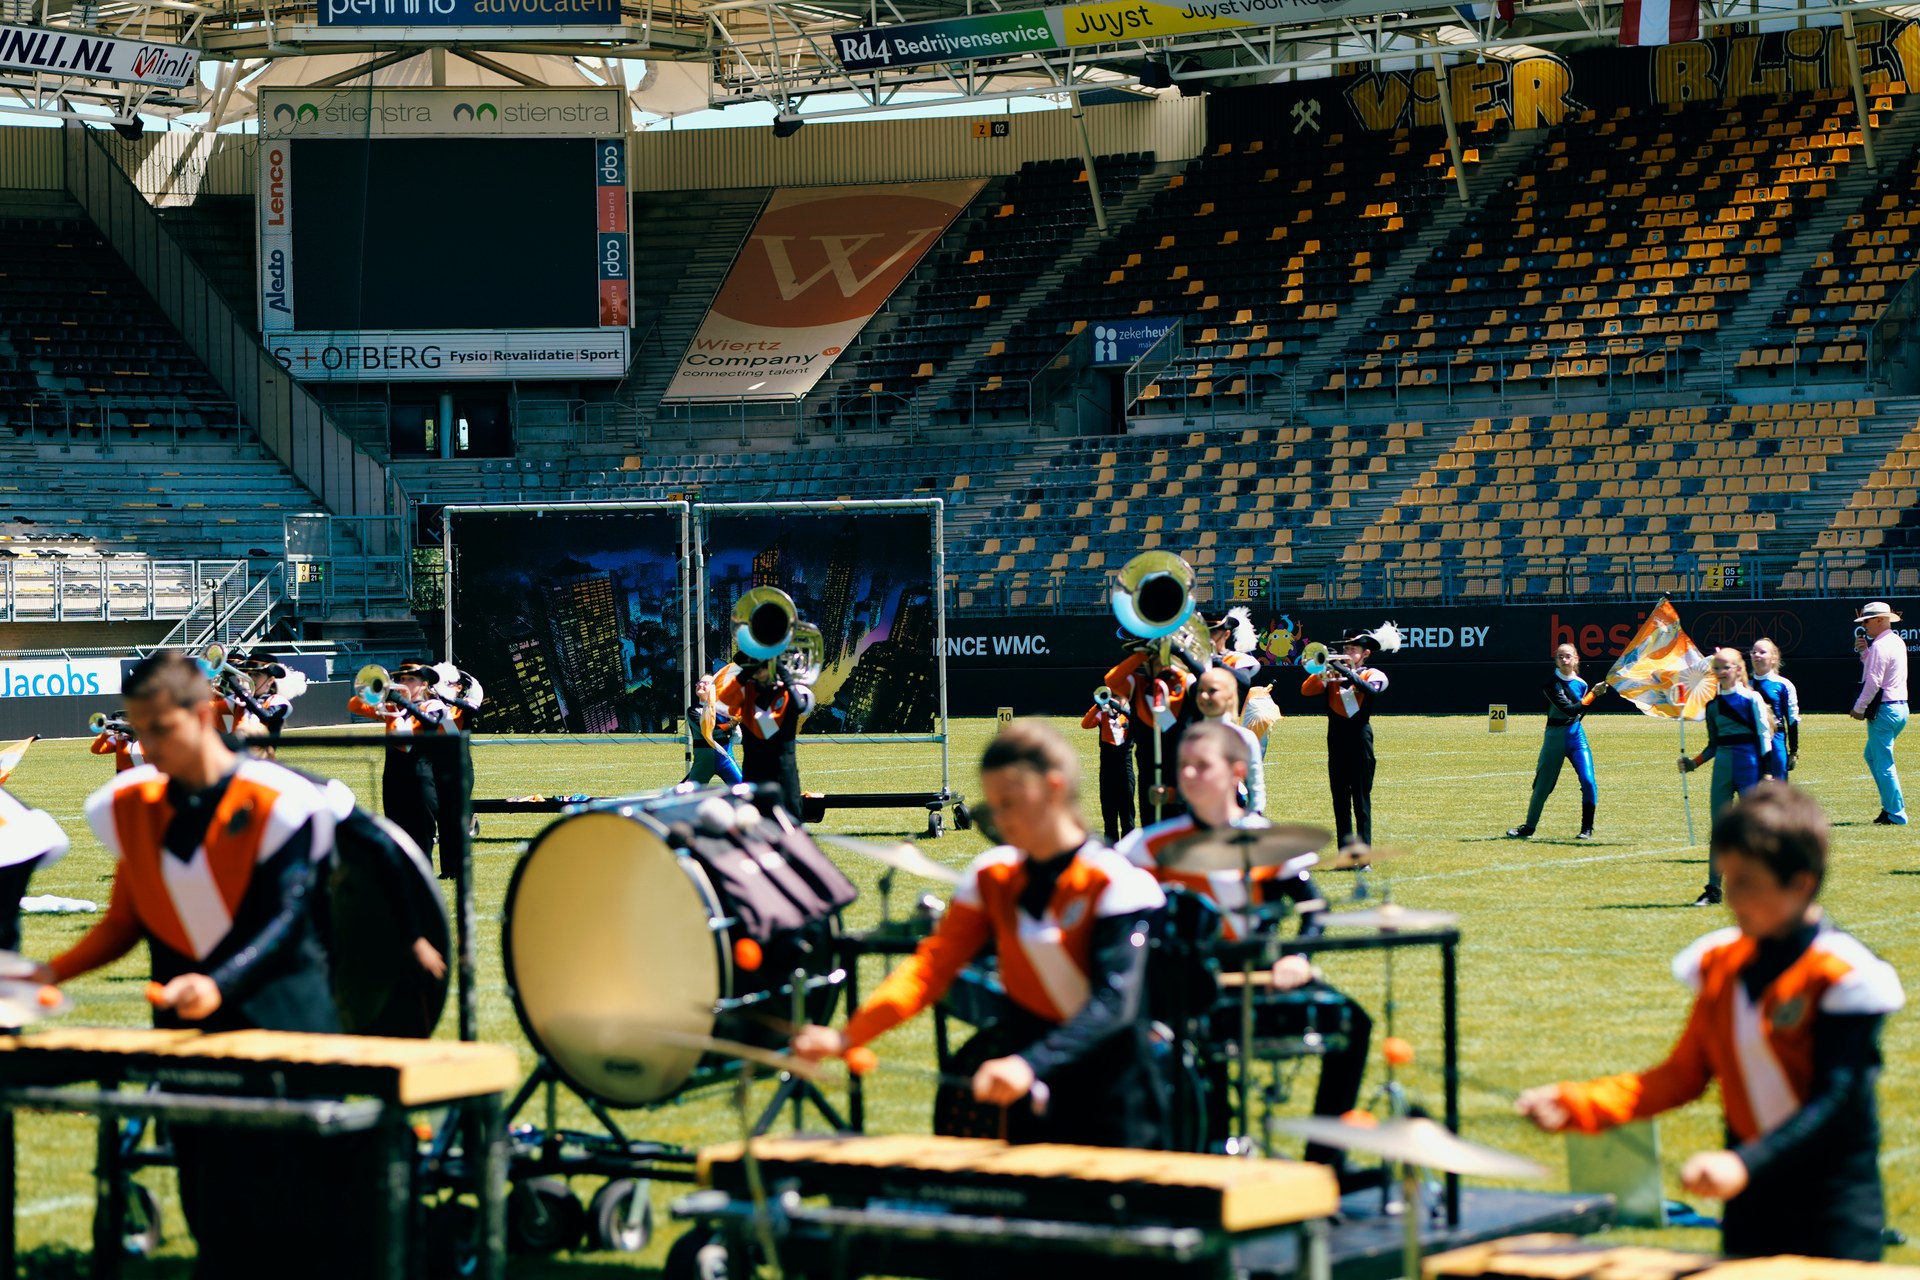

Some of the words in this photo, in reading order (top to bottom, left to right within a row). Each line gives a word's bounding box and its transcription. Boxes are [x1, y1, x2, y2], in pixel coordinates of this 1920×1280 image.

[1182, 0, 1239, 20] Juyst
[1076, 5, 1153, 38] Juyst
[840, 33, 892, 64] Rd4
[894, 24, 1050, 56] Bedrijvenservice
[131, 46, 193, 78] Minli
[325, 101, 432, 123] stienstra
[504, 101, 610, 122] stienstra
[979, 124, 985, 135] Z
[995, 124, 1005, 134] 02
[600, 146, 621, 183] capi
[268, 149, 284, 226] Lenco
[608, 192, 616, 232] EUROPE
[603, 239, 623, 277] capi
[750, 226, 943, 301] W
[696, 338, 782, 351] Wiertz
[450, 350, 488, 363] Fysio
[493, 348, 575, 362] Revalidatie
[580, 348, 620, 361] Sport
[686, 352, 819, 368] Company
[682, 369, 764, 378] connecting
[769, 367, 809, 376] talent
[1725, 567, 1735, 576] 05
[1249, 579, 1258, 587] 03
[1249, 589, 1258, 597] 05
[1725, 578, 1735, 587] 07
[992, 634, 1050, 656] WMC.
[1461, 626, 1490, 648] BY
[1, 664, 99, 697] Jacobs
[1000, 713, 1012, 721] 10
[1491, 710, 1506, 720] 20
